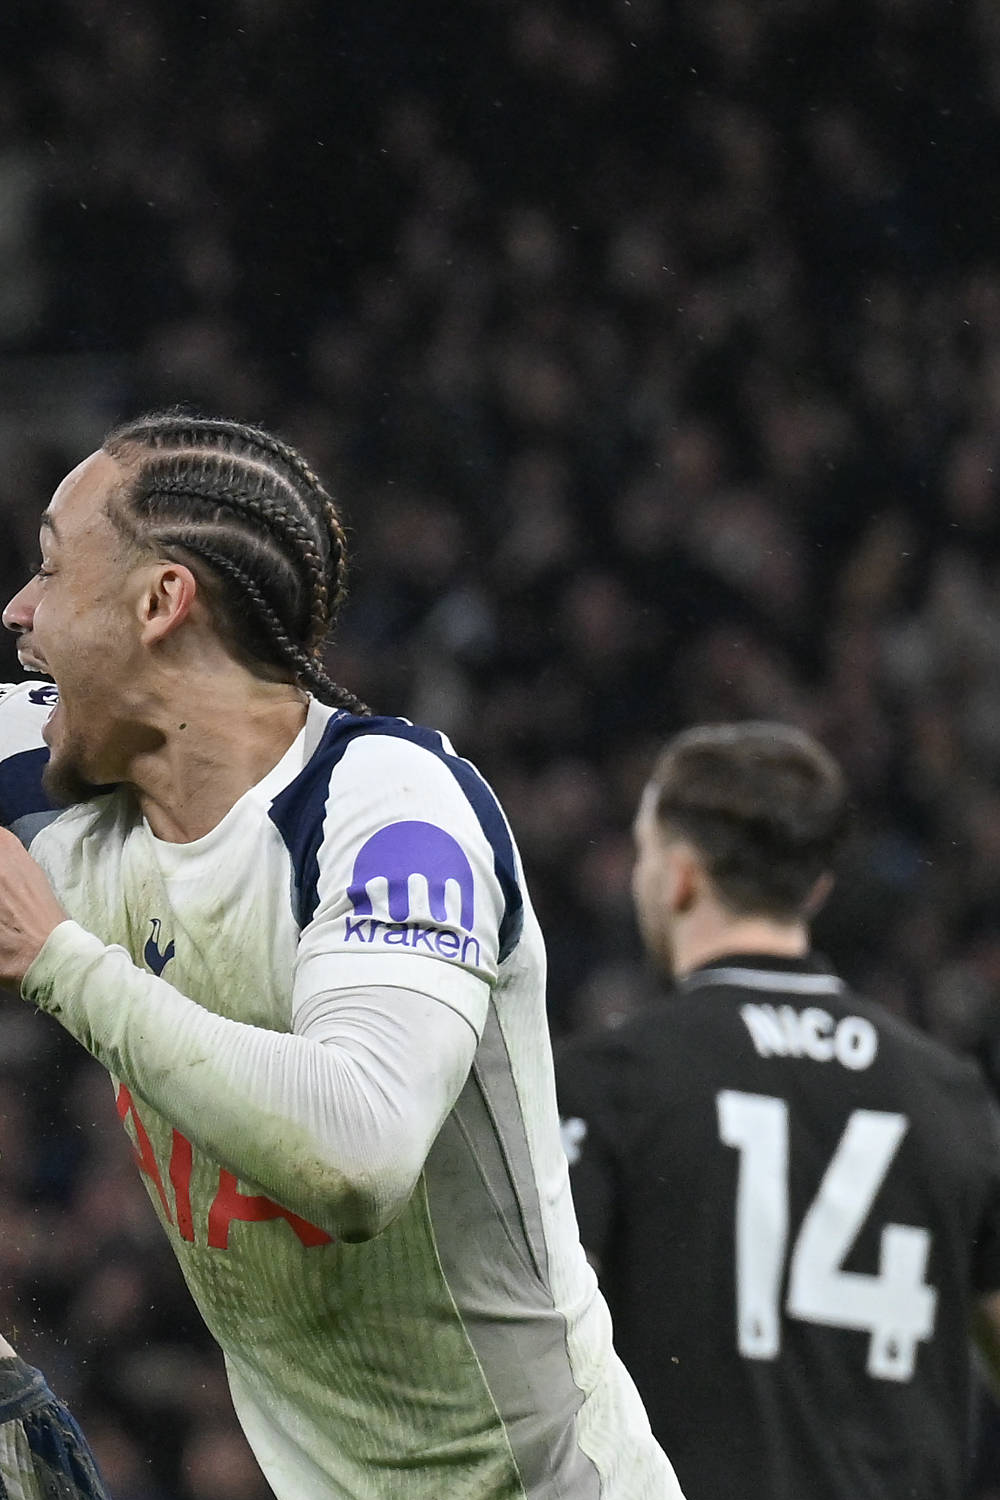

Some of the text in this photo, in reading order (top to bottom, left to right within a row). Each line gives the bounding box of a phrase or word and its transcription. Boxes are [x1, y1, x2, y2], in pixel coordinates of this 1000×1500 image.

[344, 917, 480, 966] kraken
[740, 1003, 878, 1071] NICO
[716, 1089, 936, 1382] 14
